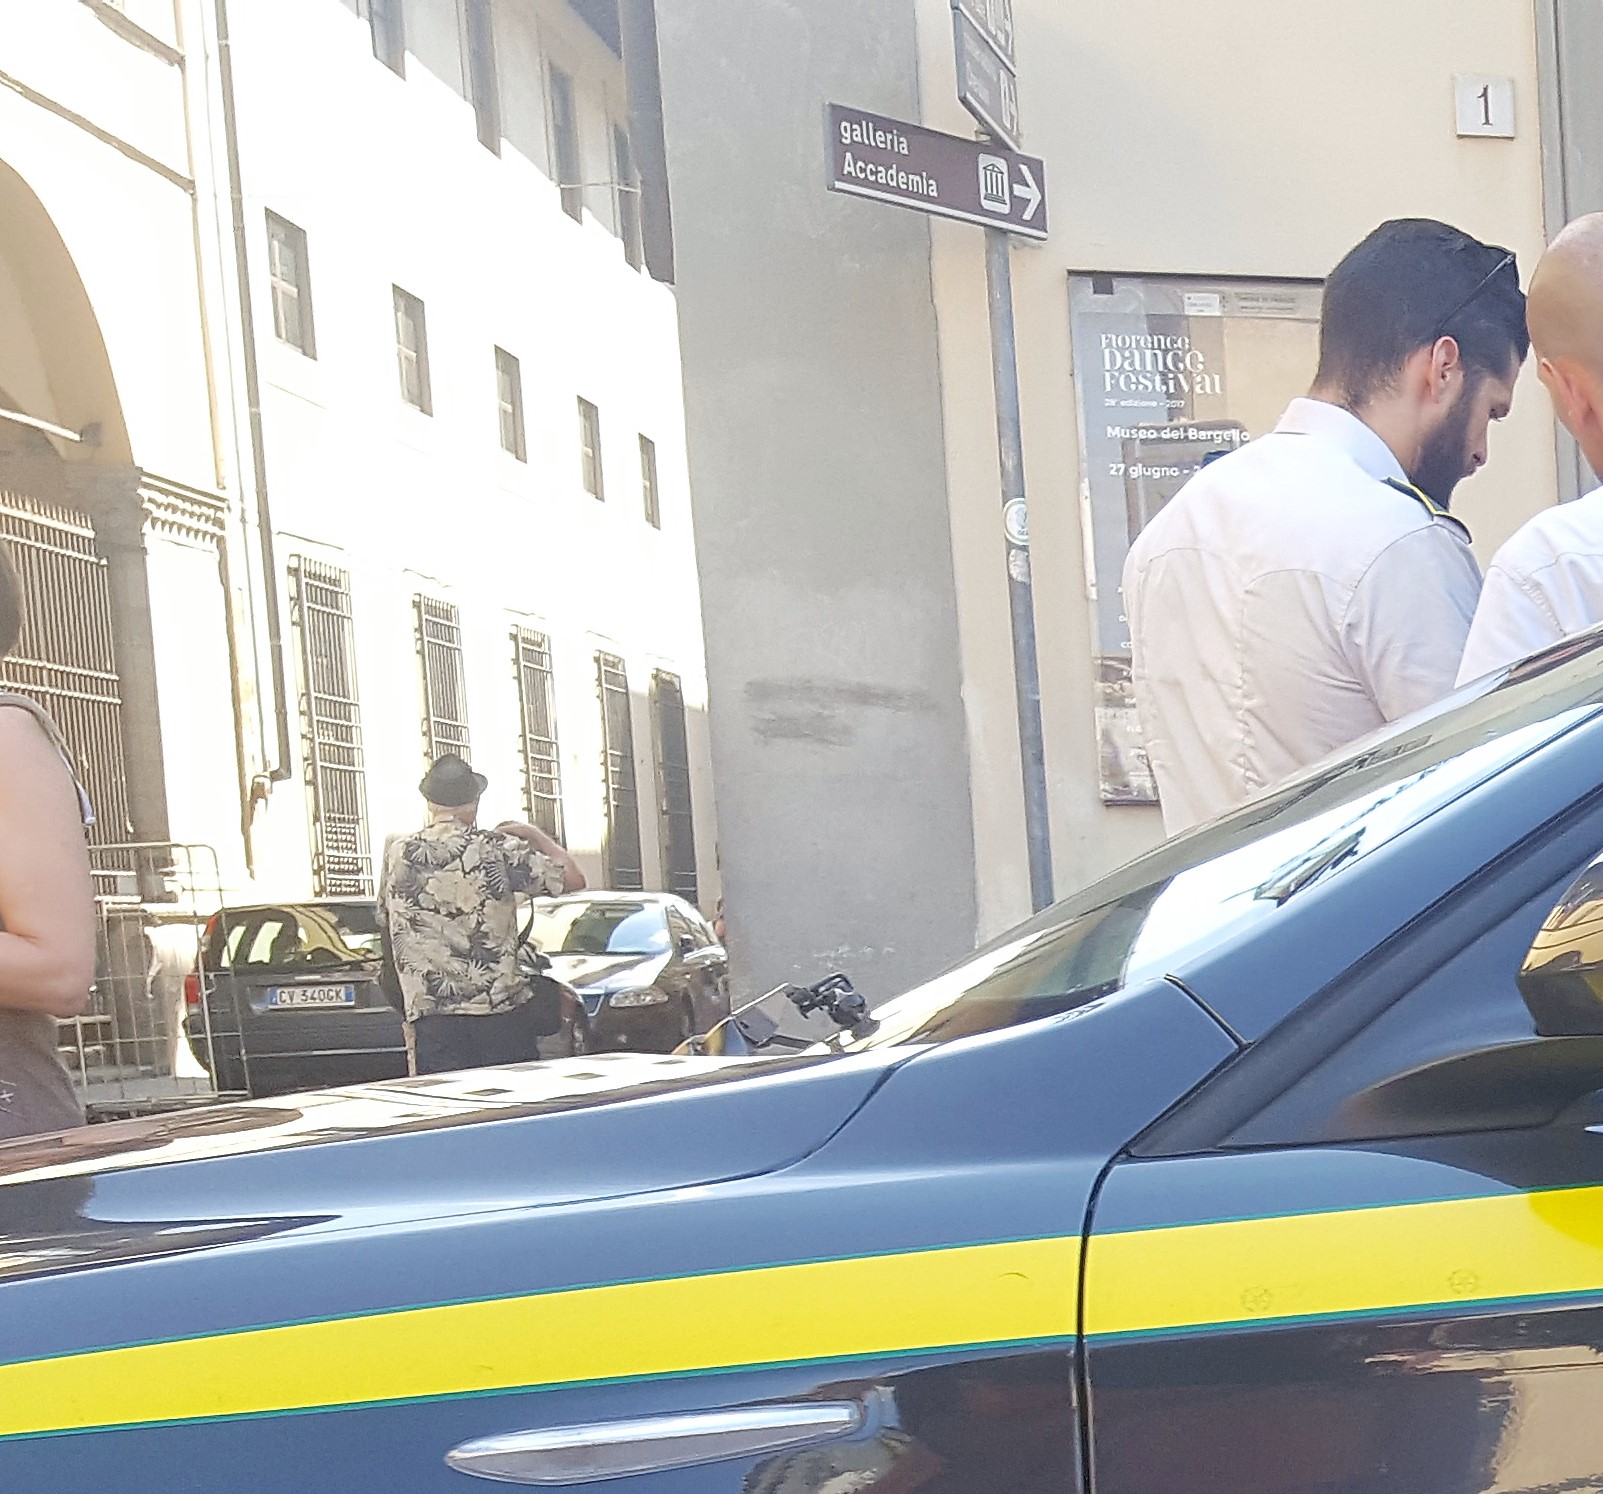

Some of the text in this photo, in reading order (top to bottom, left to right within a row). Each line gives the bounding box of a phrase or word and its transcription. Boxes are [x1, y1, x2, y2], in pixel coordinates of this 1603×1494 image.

[1477, 84, 1493, 126] 1
[840, 119, 909, 155] galleria
[842, 152, 939, 198] Accademia
[1106, 426, 1250, 444] Museo del Bargello
[1109, 463, 1126, 476] 27
[1129, 463, 1179, 479] giugno
[279, 990, 295, 1004] CV
